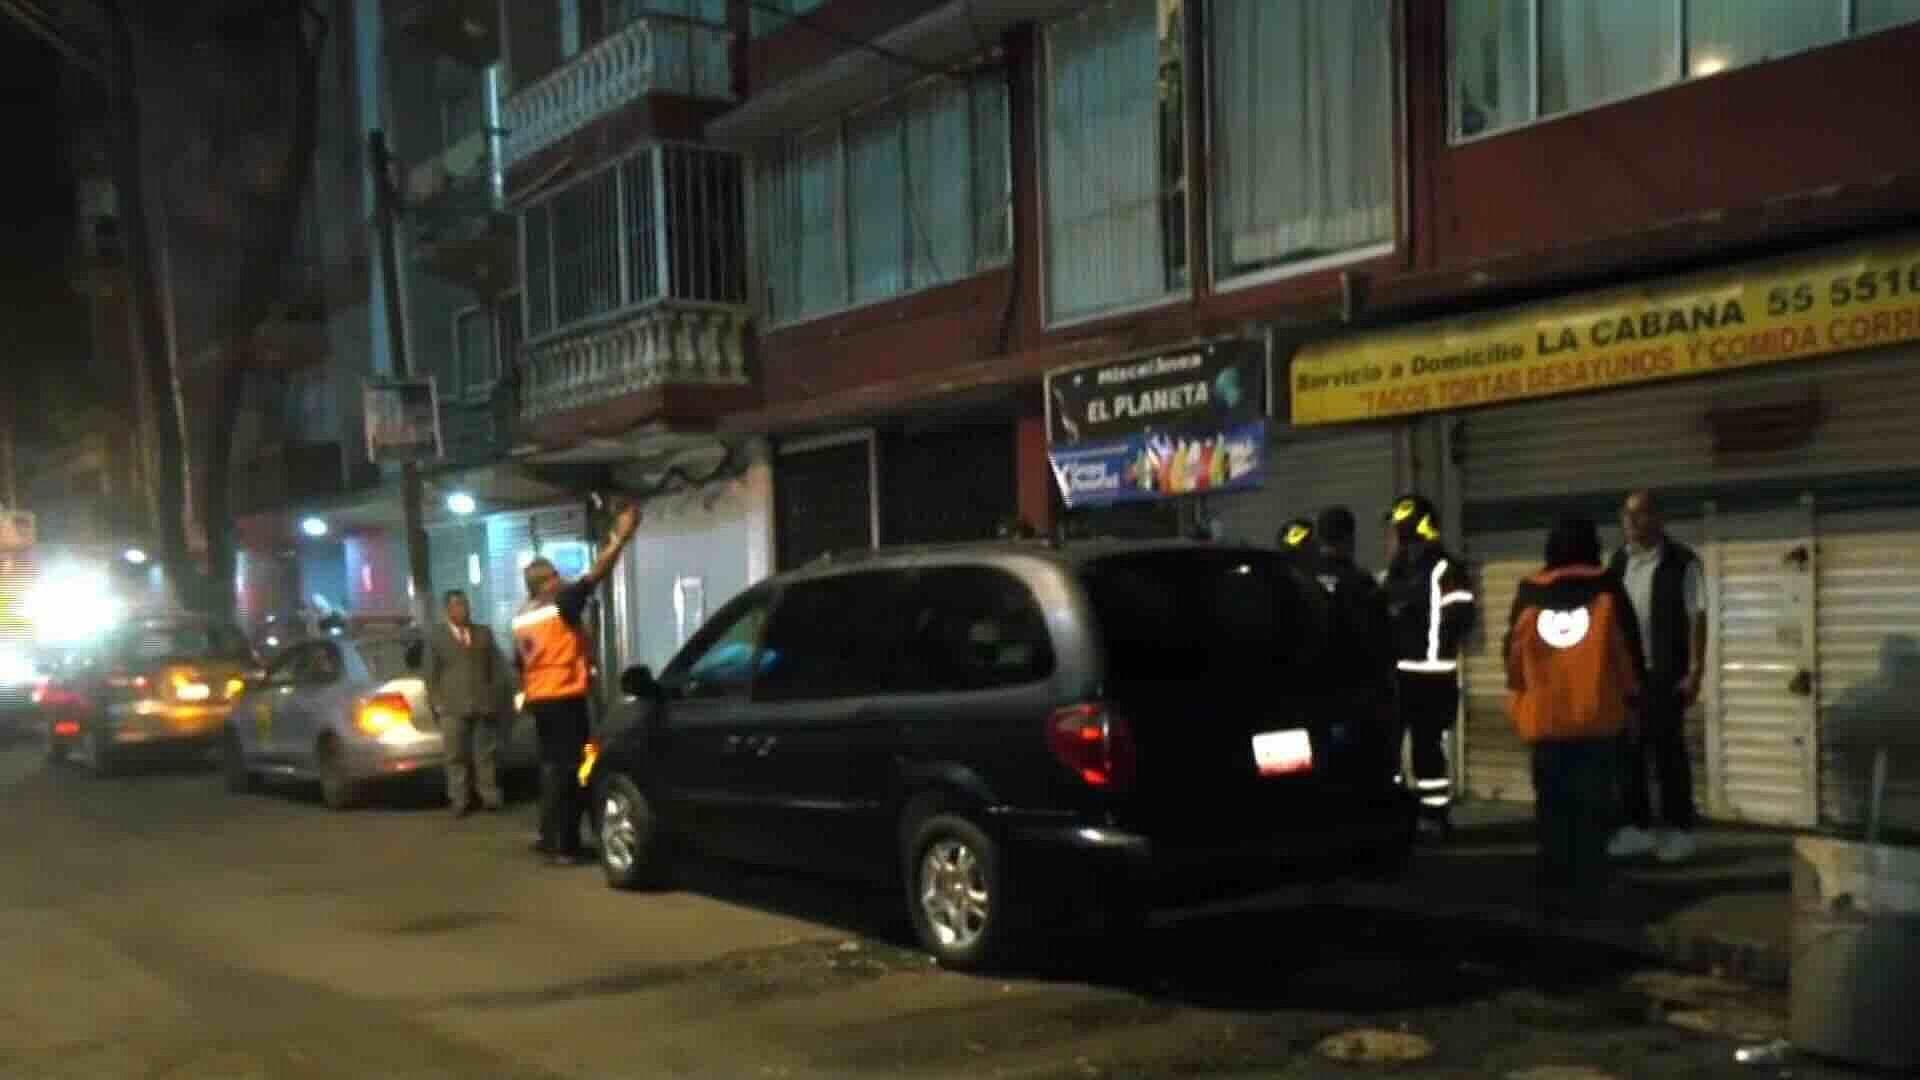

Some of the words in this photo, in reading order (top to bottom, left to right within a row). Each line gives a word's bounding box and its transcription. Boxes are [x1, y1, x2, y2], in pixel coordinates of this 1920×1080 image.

[1389, 366, 1404, 379] a
[1410, 343, 1525, 375] Domicilio
[1537, 324, 1579, 356] LA
[1767, 282, 1815, 317] 55
[1688, 338, 1704, 367] Y
[1707, 322, 1819, 363] COMIDA
[1086, 400, 1112, 425] EL
[1114, 381, 1209, 418] PLANETA
